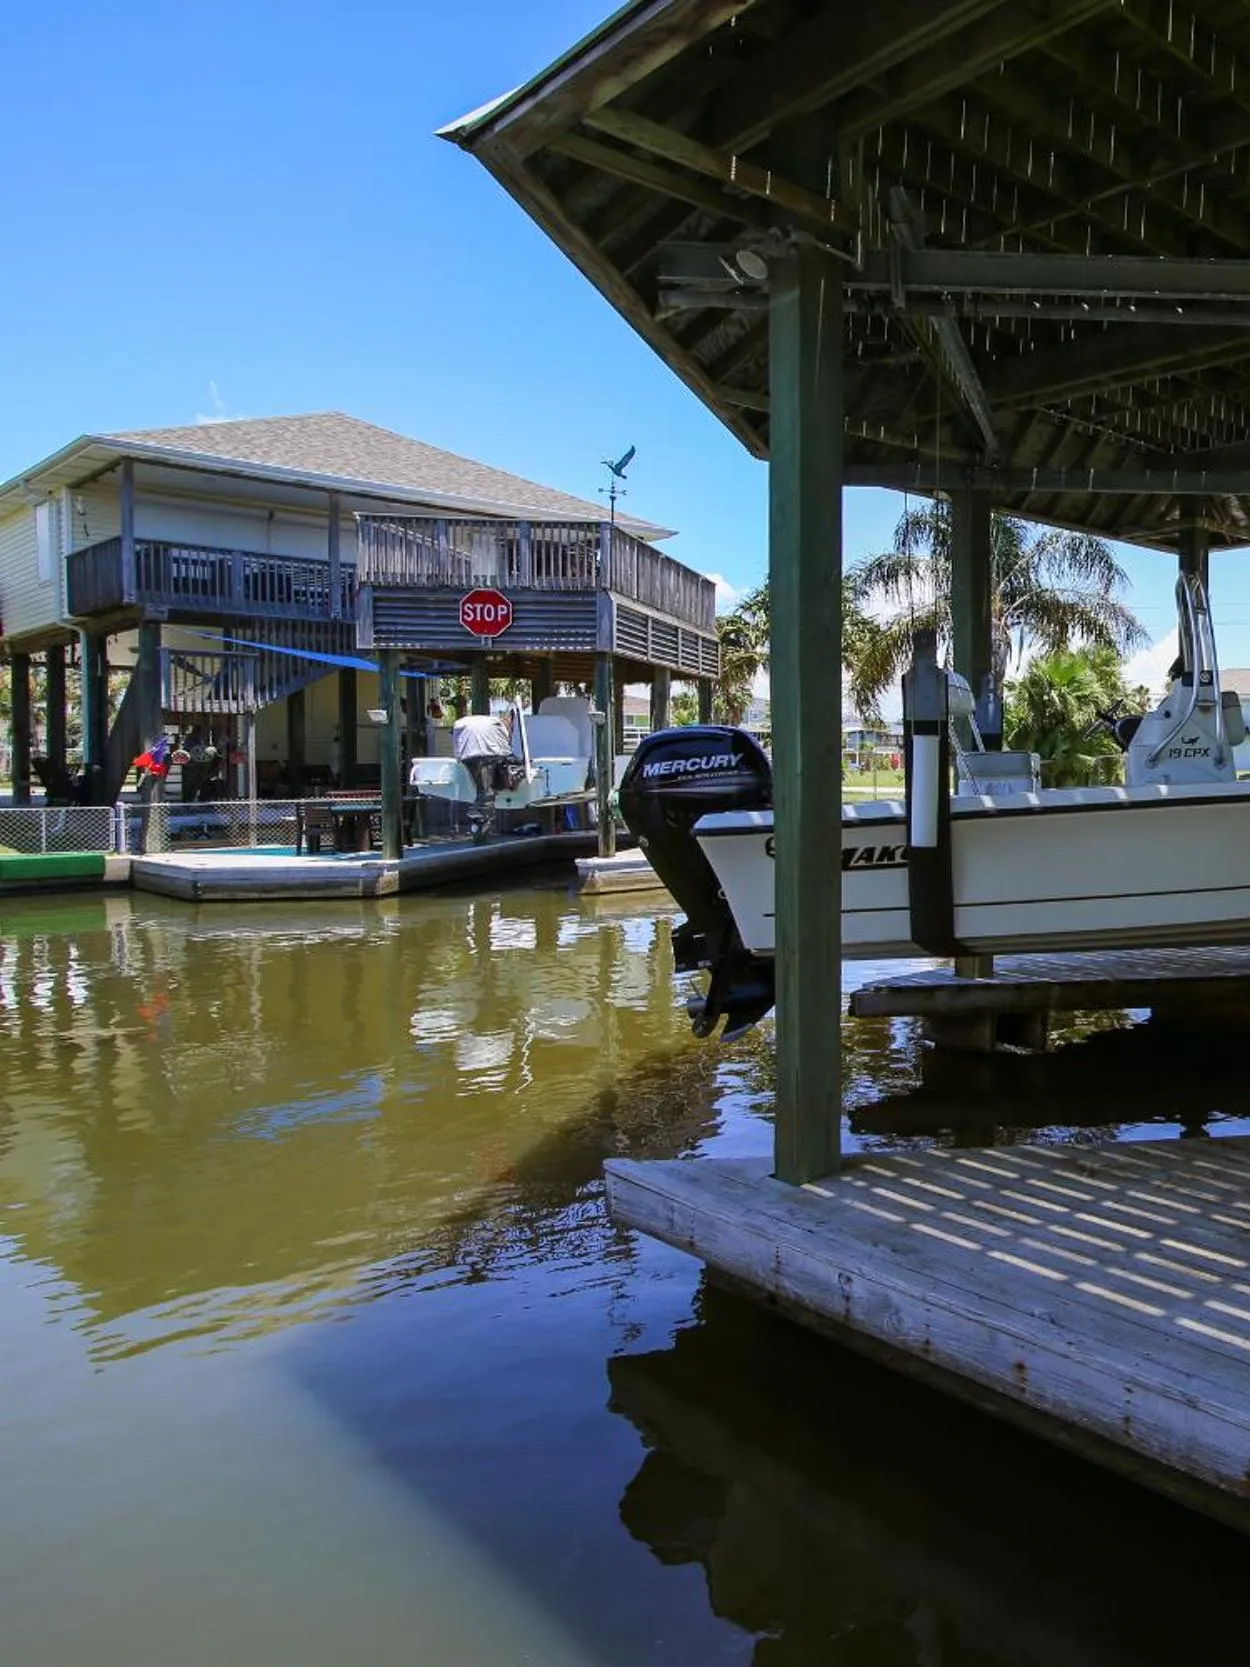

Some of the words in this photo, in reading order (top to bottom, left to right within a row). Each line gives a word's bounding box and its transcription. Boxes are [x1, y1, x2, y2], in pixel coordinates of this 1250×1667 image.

[463, 603, 508, 621] STOP
[1169, 747, 1181, 759] 19
[642, 752, 744, 778] MERCURY
